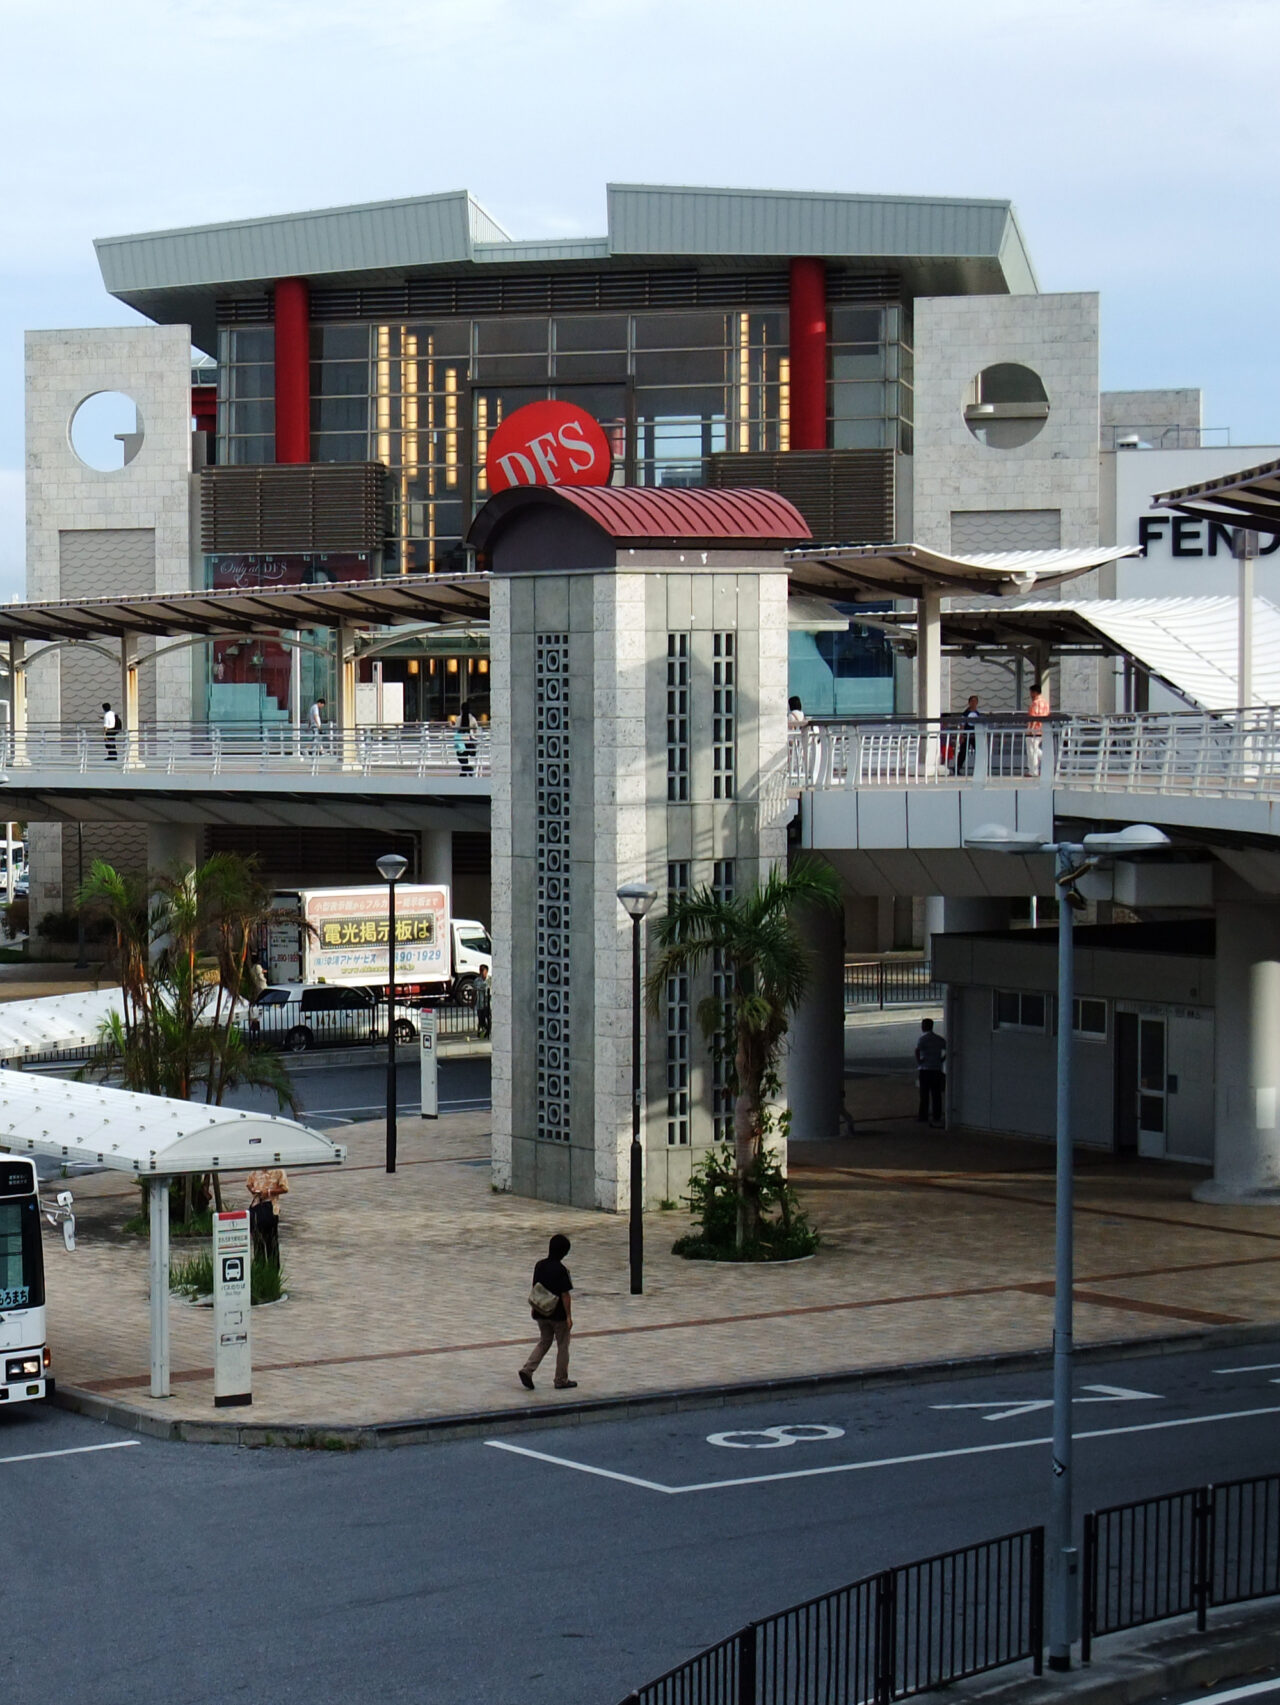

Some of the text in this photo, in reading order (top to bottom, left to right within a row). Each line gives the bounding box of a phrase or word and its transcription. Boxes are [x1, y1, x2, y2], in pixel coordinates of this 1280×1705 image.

[496, 420, 595, 487] DFS
[221, 560, 248, 587] Only
[263, 562, 287, 576] DFS
[323, 919, 430, 945] 電光掲示板は
